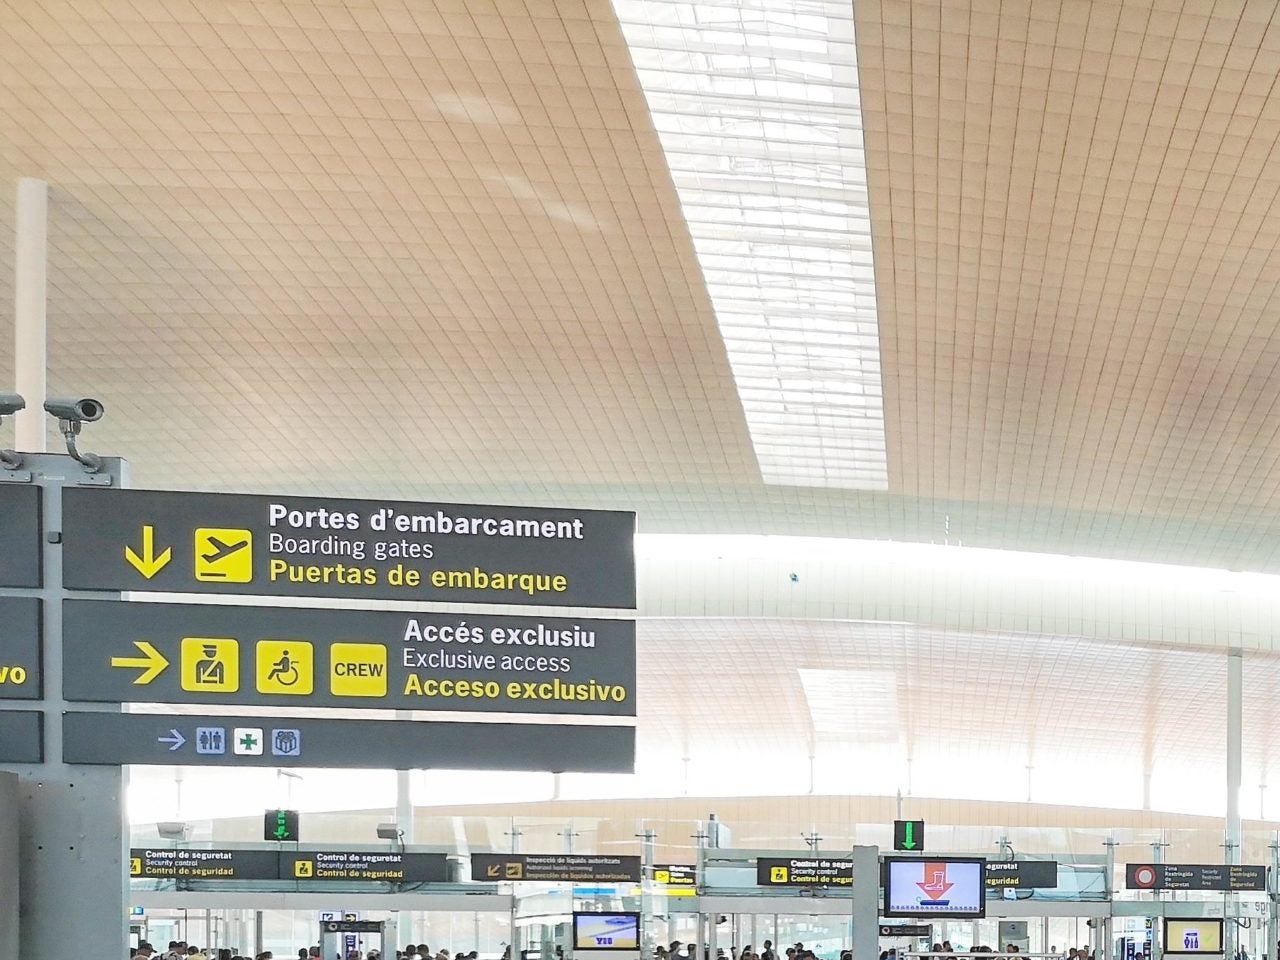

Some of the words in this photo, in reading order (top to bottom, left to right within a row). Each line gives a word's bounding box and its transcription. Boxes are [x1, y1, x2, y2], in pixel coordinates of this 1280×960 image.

[269, 504, 360, 531] Portes
[370, 507, 584, 539] d'embarcament
[270, 533, 368, 559] Boarding
[374, 537, 434, 561] gates
[270, 560, 377, 586] Puertas
[388, 564, 421, 587] de
[431, 566, 568, 596] embarque
[404, 619, 485, 646] Accés
[491, 622, 596, 648] exclusiu
[404, 648, 499, 672] Exclusive
[502, 653, 571, 673] access
[335, 660, 384, 679] CREW
[404, 674, 500, 699] Acceso
[507, 677, 626, 703] exclusivo
[179, 851, 189, 859] de
[192, 852, 232, 860] seguretat
[317, 853, 347, 861] Control
[362, 854, 402, 863] seguretat
[146, 859, 173, 867] Security
[317, 862, 344, 870] Security
[791, 860, 818, 868] Control
[985, 863, 1018, 871] eguretat
[179, 867, 189, 875] de
[192, 867, 234, 876] seguridad
[317, 869, 347, 877] Control
[362, 870, 403, 879] seguridad
[791, 868, 815, 876] Security
[791, 875, 818, 884] Control
[985, 877, 1019, 886] eguridad
